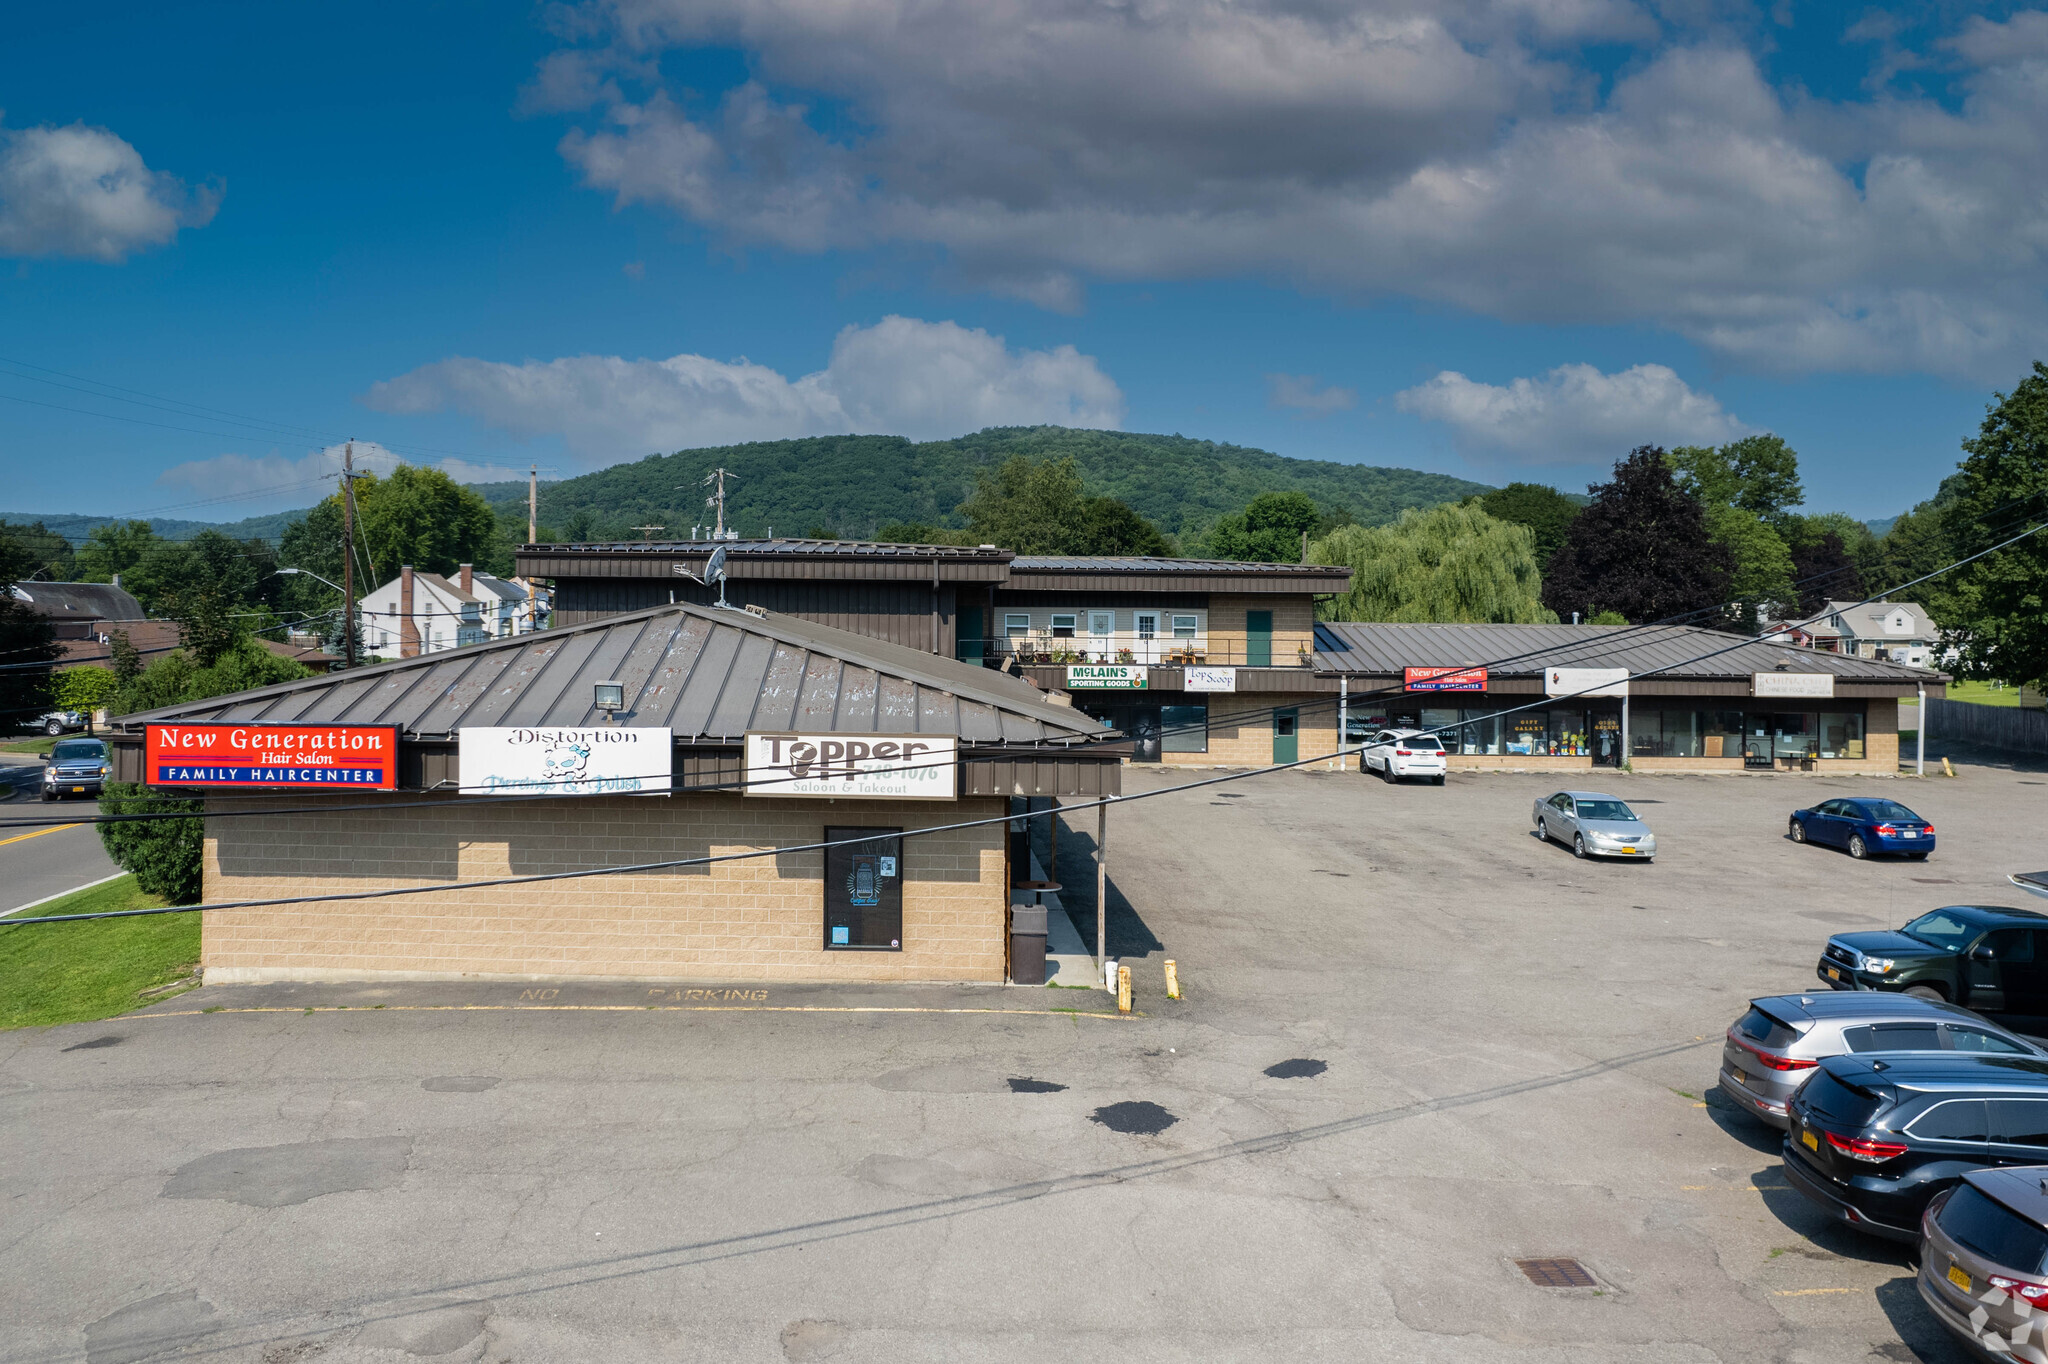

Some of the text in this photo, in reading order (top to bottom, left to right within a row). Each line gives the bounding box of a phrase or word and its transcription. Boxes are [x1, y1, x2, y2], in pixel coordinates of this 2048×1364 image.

[1188, 667, 1233, 687] Top Scoop
[1410, 668, 1432, 677] New
[159, 728, 383, 750] New Generation
[507, 728, 638, 745] Distortion
[260, 751, 334, 765] Hair Salon
[168, 768, 375, 782] FAMILY HAIRCENTER
[862, 763, 939, 782] 748-1076
[481, 774, 642, 794] Piercings & Polish
[793, 781, 908, 794] Saloon & Takeout
[519, 988, 560, 1001] NO
